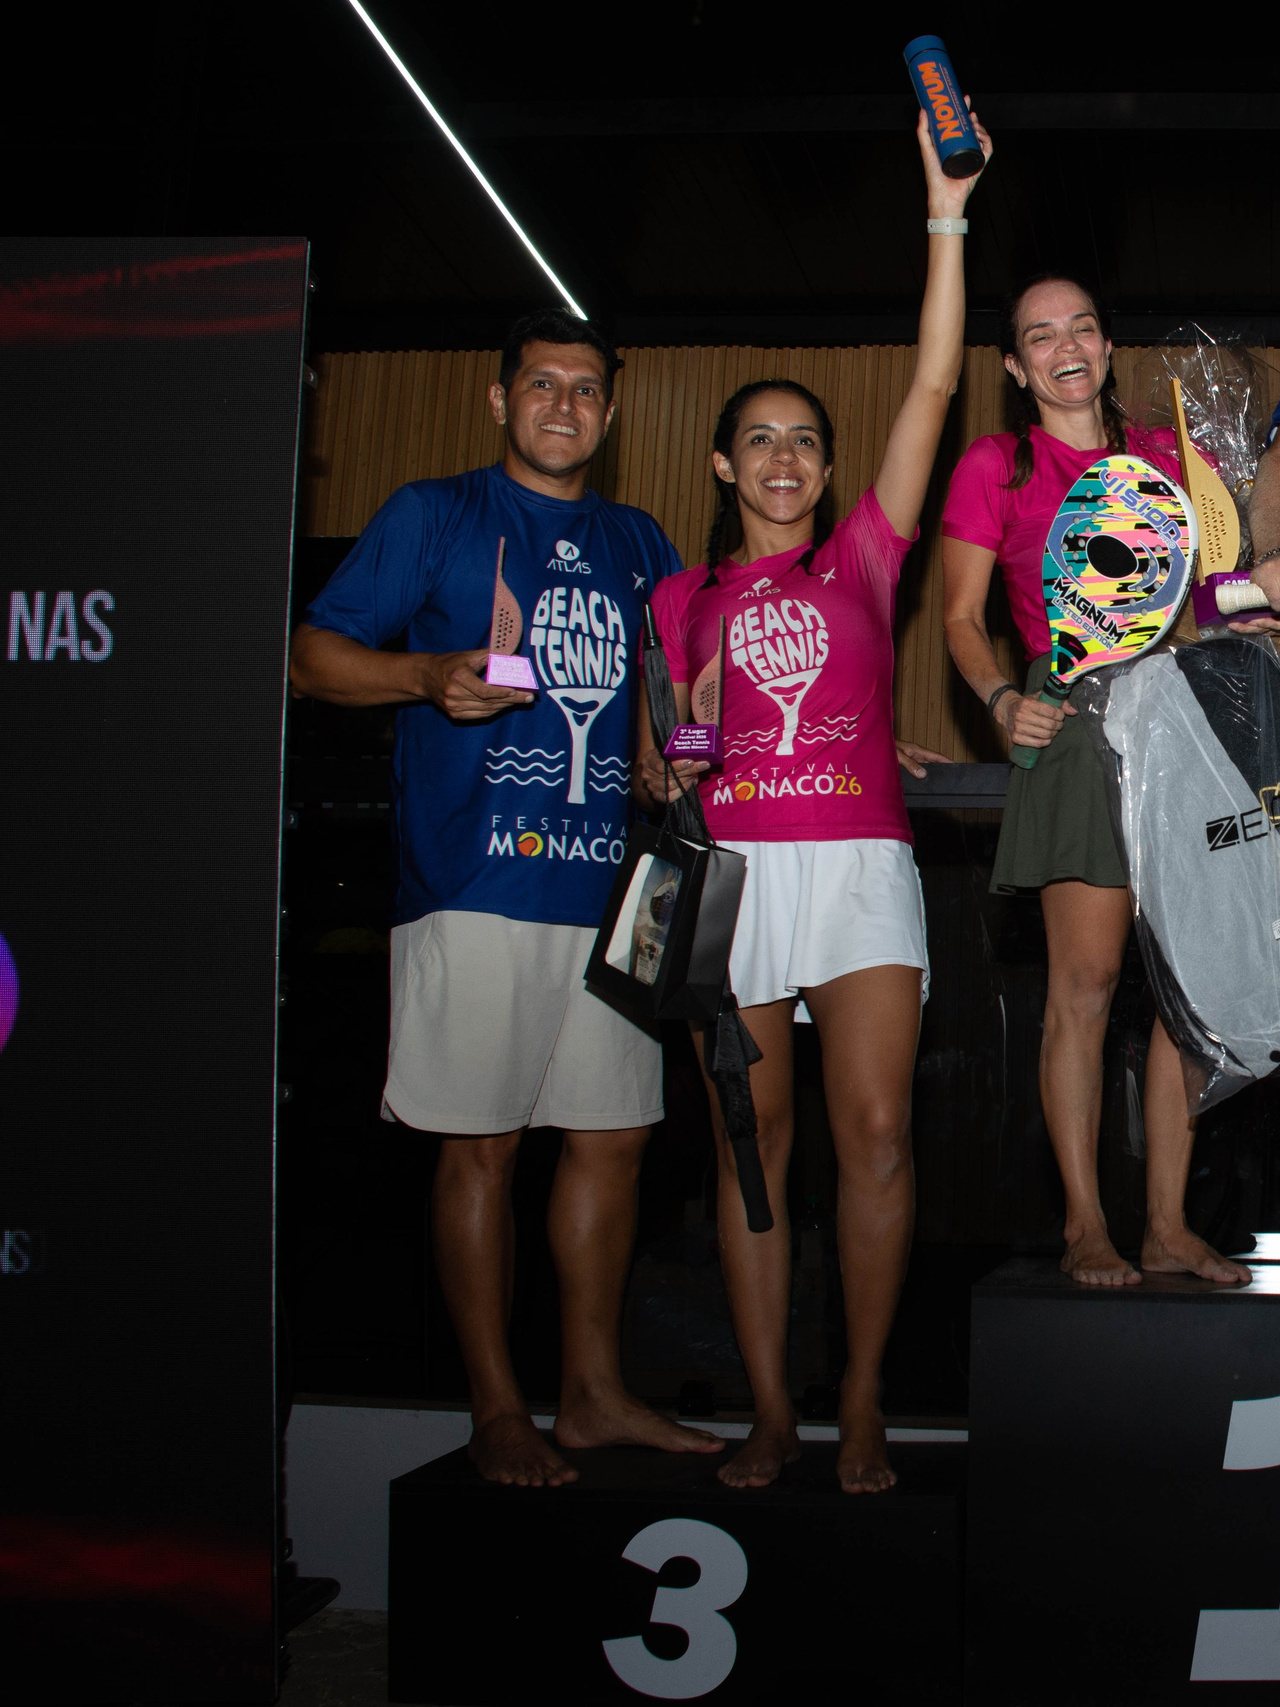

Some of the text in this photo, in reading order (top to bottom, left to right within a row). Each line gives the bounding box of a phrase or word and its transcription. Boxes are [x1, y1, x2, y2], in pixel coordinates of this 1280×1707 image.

[917, 61, 964, 143] NOVUM
[546, 559, 592, 575] ATLAS
[737, 587, 781, 600] ATLAS
[1051, 573, 1130, 645] MAGNUM
[7, 589, 116, 662] NAS
[532, 586, 627, 645] BEACH
[729, 599, 827, 650] BEACH
[731, 628, 829, 684] TENNIS
[1081, 620, 1115, 654] EDITION
[530, 627, 628, 690] TENNIS
[688, 728, 707, 736] Lugar
[713, 774, 862, 806] MONACO26
[717, 762, 853, 789] FESTIVAL
[492, 814, 627, 839] FESTIVA
[487, 831, 626, 865] MONACO
[601, 1517, 748, 1700] 3
